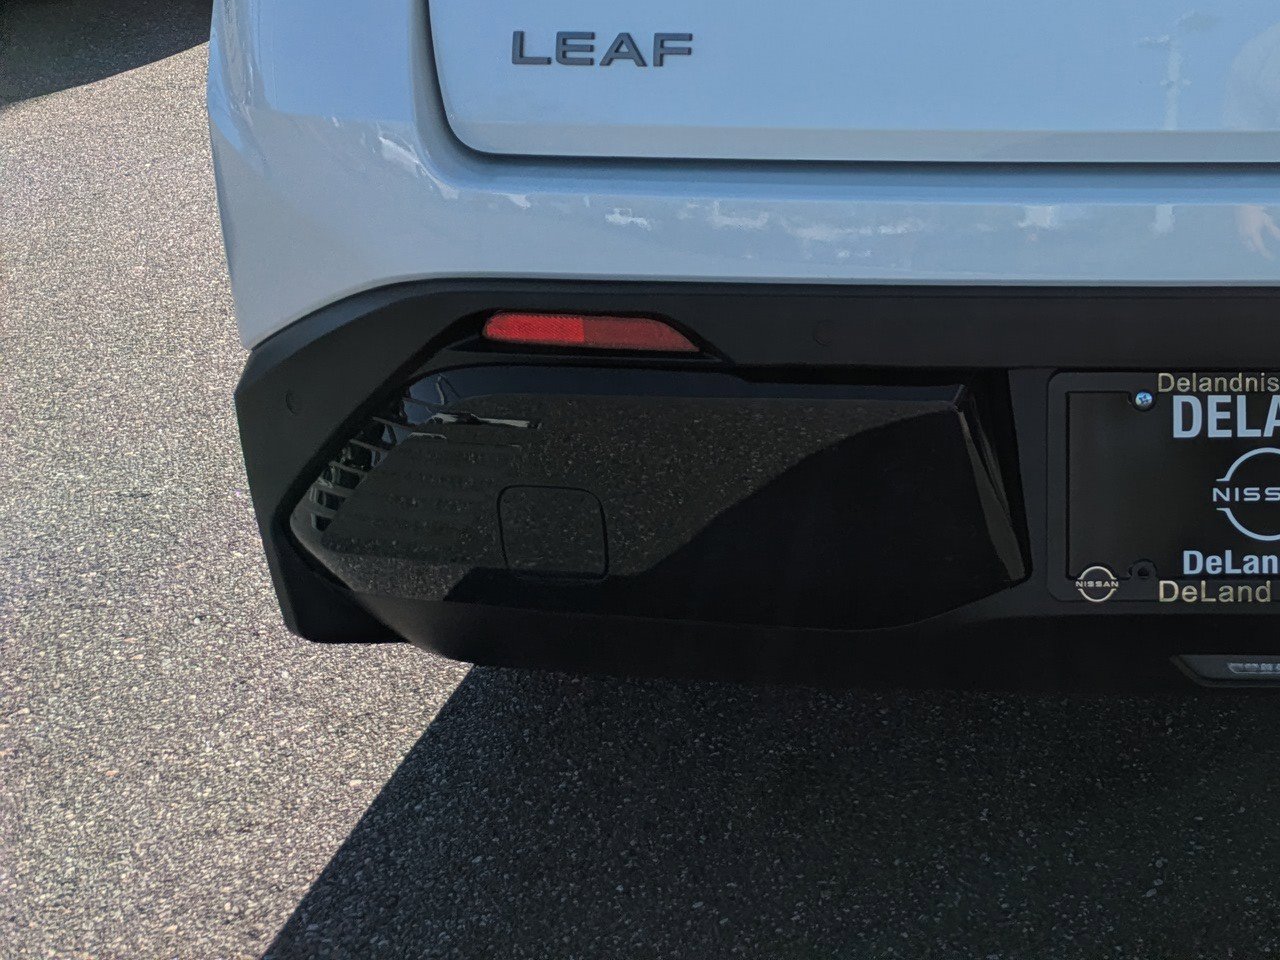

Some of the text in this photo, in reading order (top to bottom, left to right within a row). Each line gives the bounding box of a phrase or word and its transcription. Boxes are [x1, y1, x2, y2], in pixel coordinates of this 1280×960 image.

[511, 30, 693, 67] LEAF
[1075, 580, 1119, 588] NISSAN
[1159, 581, 1271, 603] DeLand
